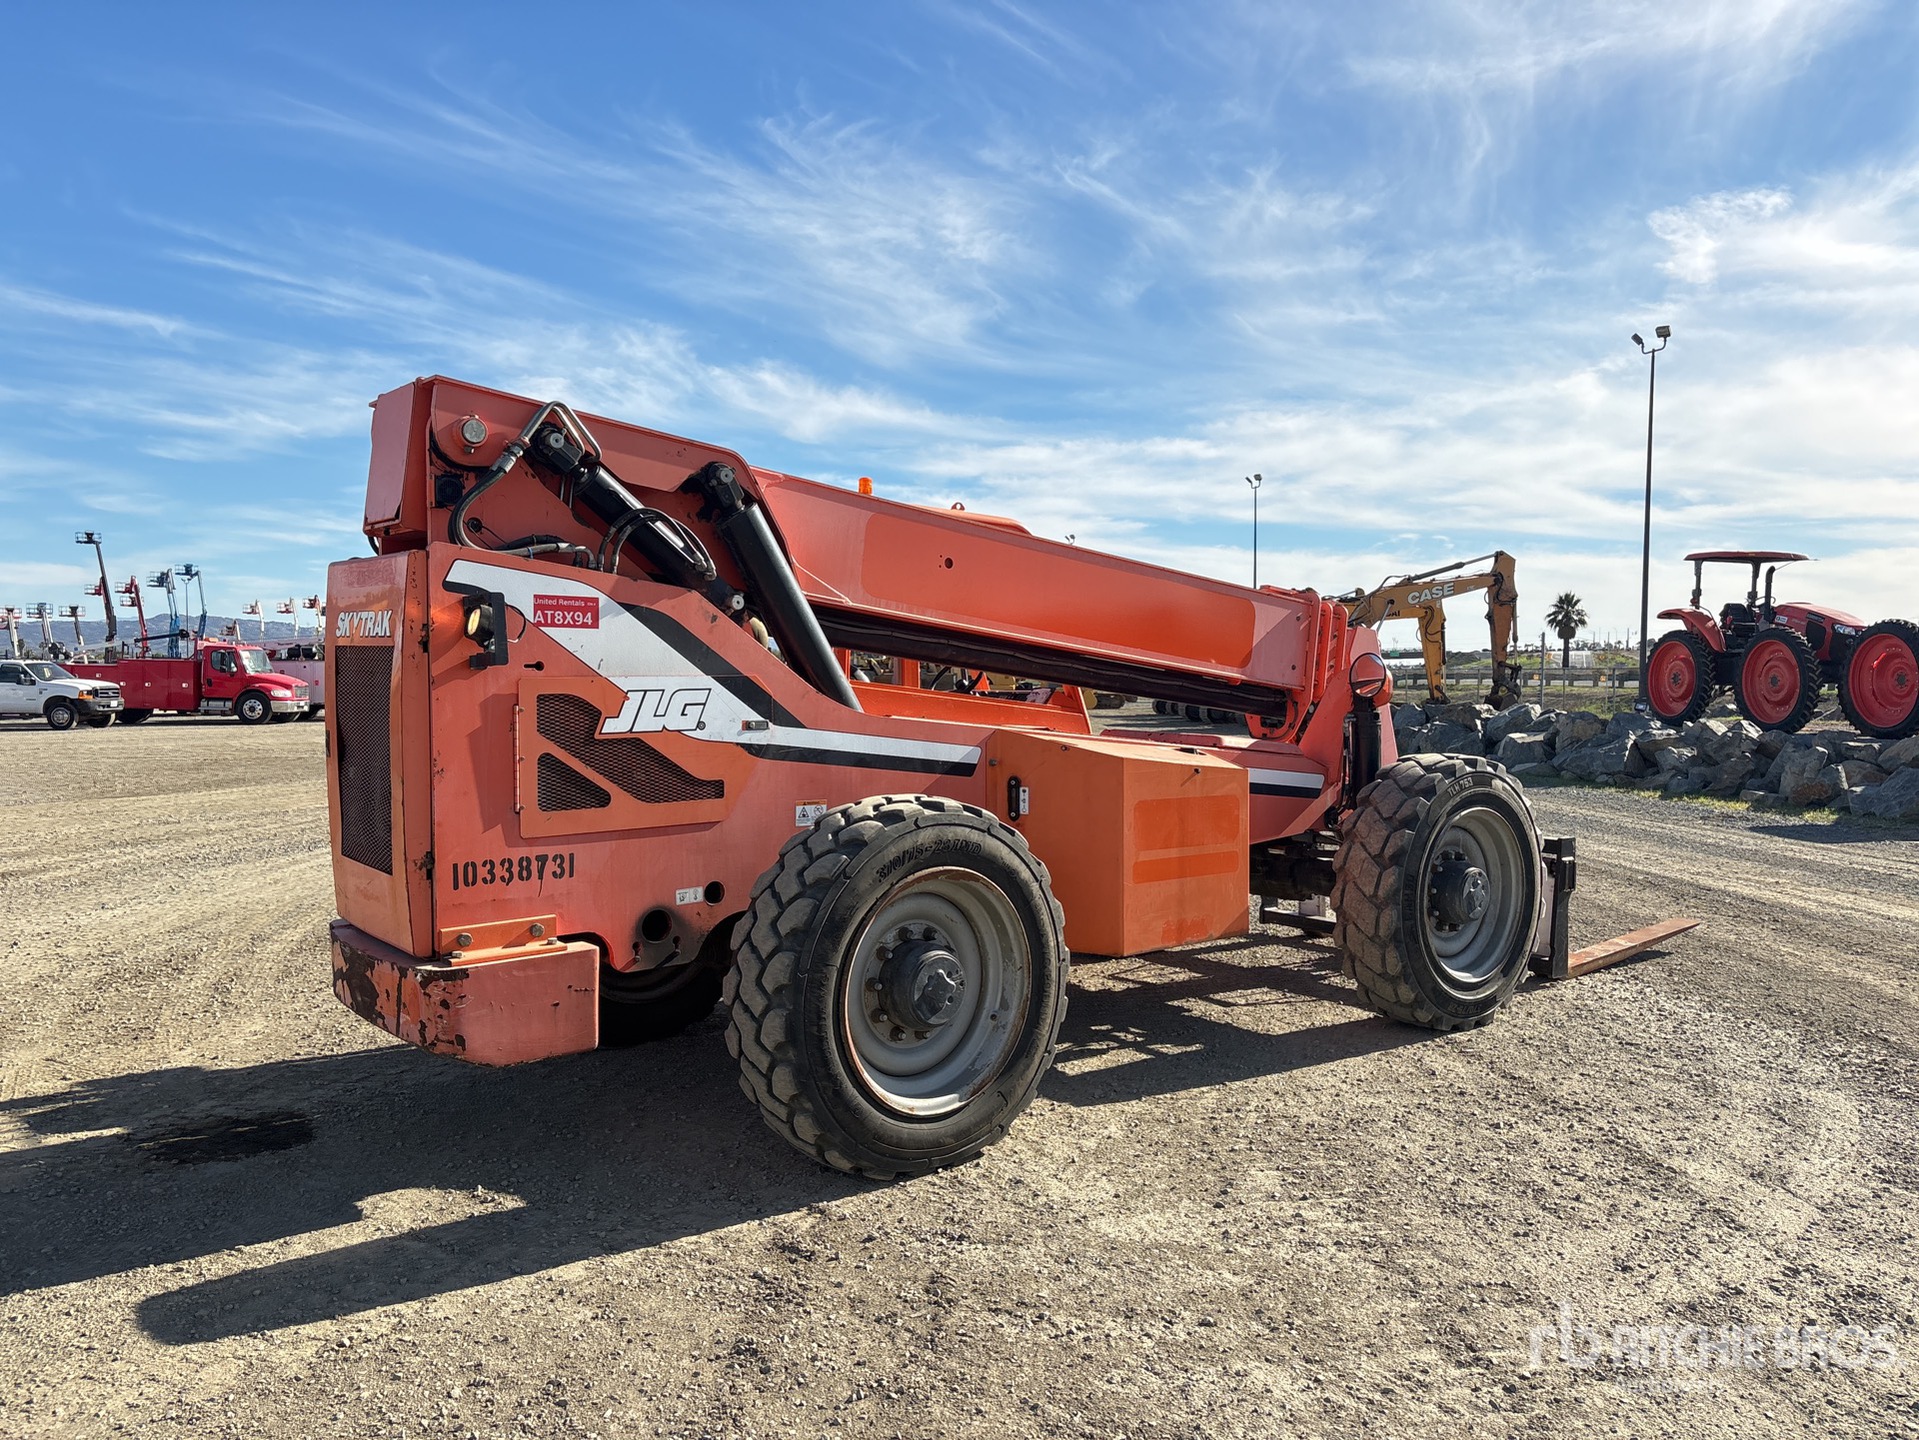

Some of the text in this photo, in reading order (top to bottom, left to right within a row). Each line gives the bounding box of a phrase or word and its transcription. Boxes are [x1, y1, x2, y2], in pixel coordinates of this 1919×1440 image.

[534, 597, 557, 605] United
[558, 598, 585, 607] Rentals
[1407, 582, 1455, 605] CASE
[335, 610, 393, 638] SKYTRAK
[534, 610, 593, 625] AT8X94
[599, 688, 712, 735] JLG
[452, 852, 575, 891] 10338731
